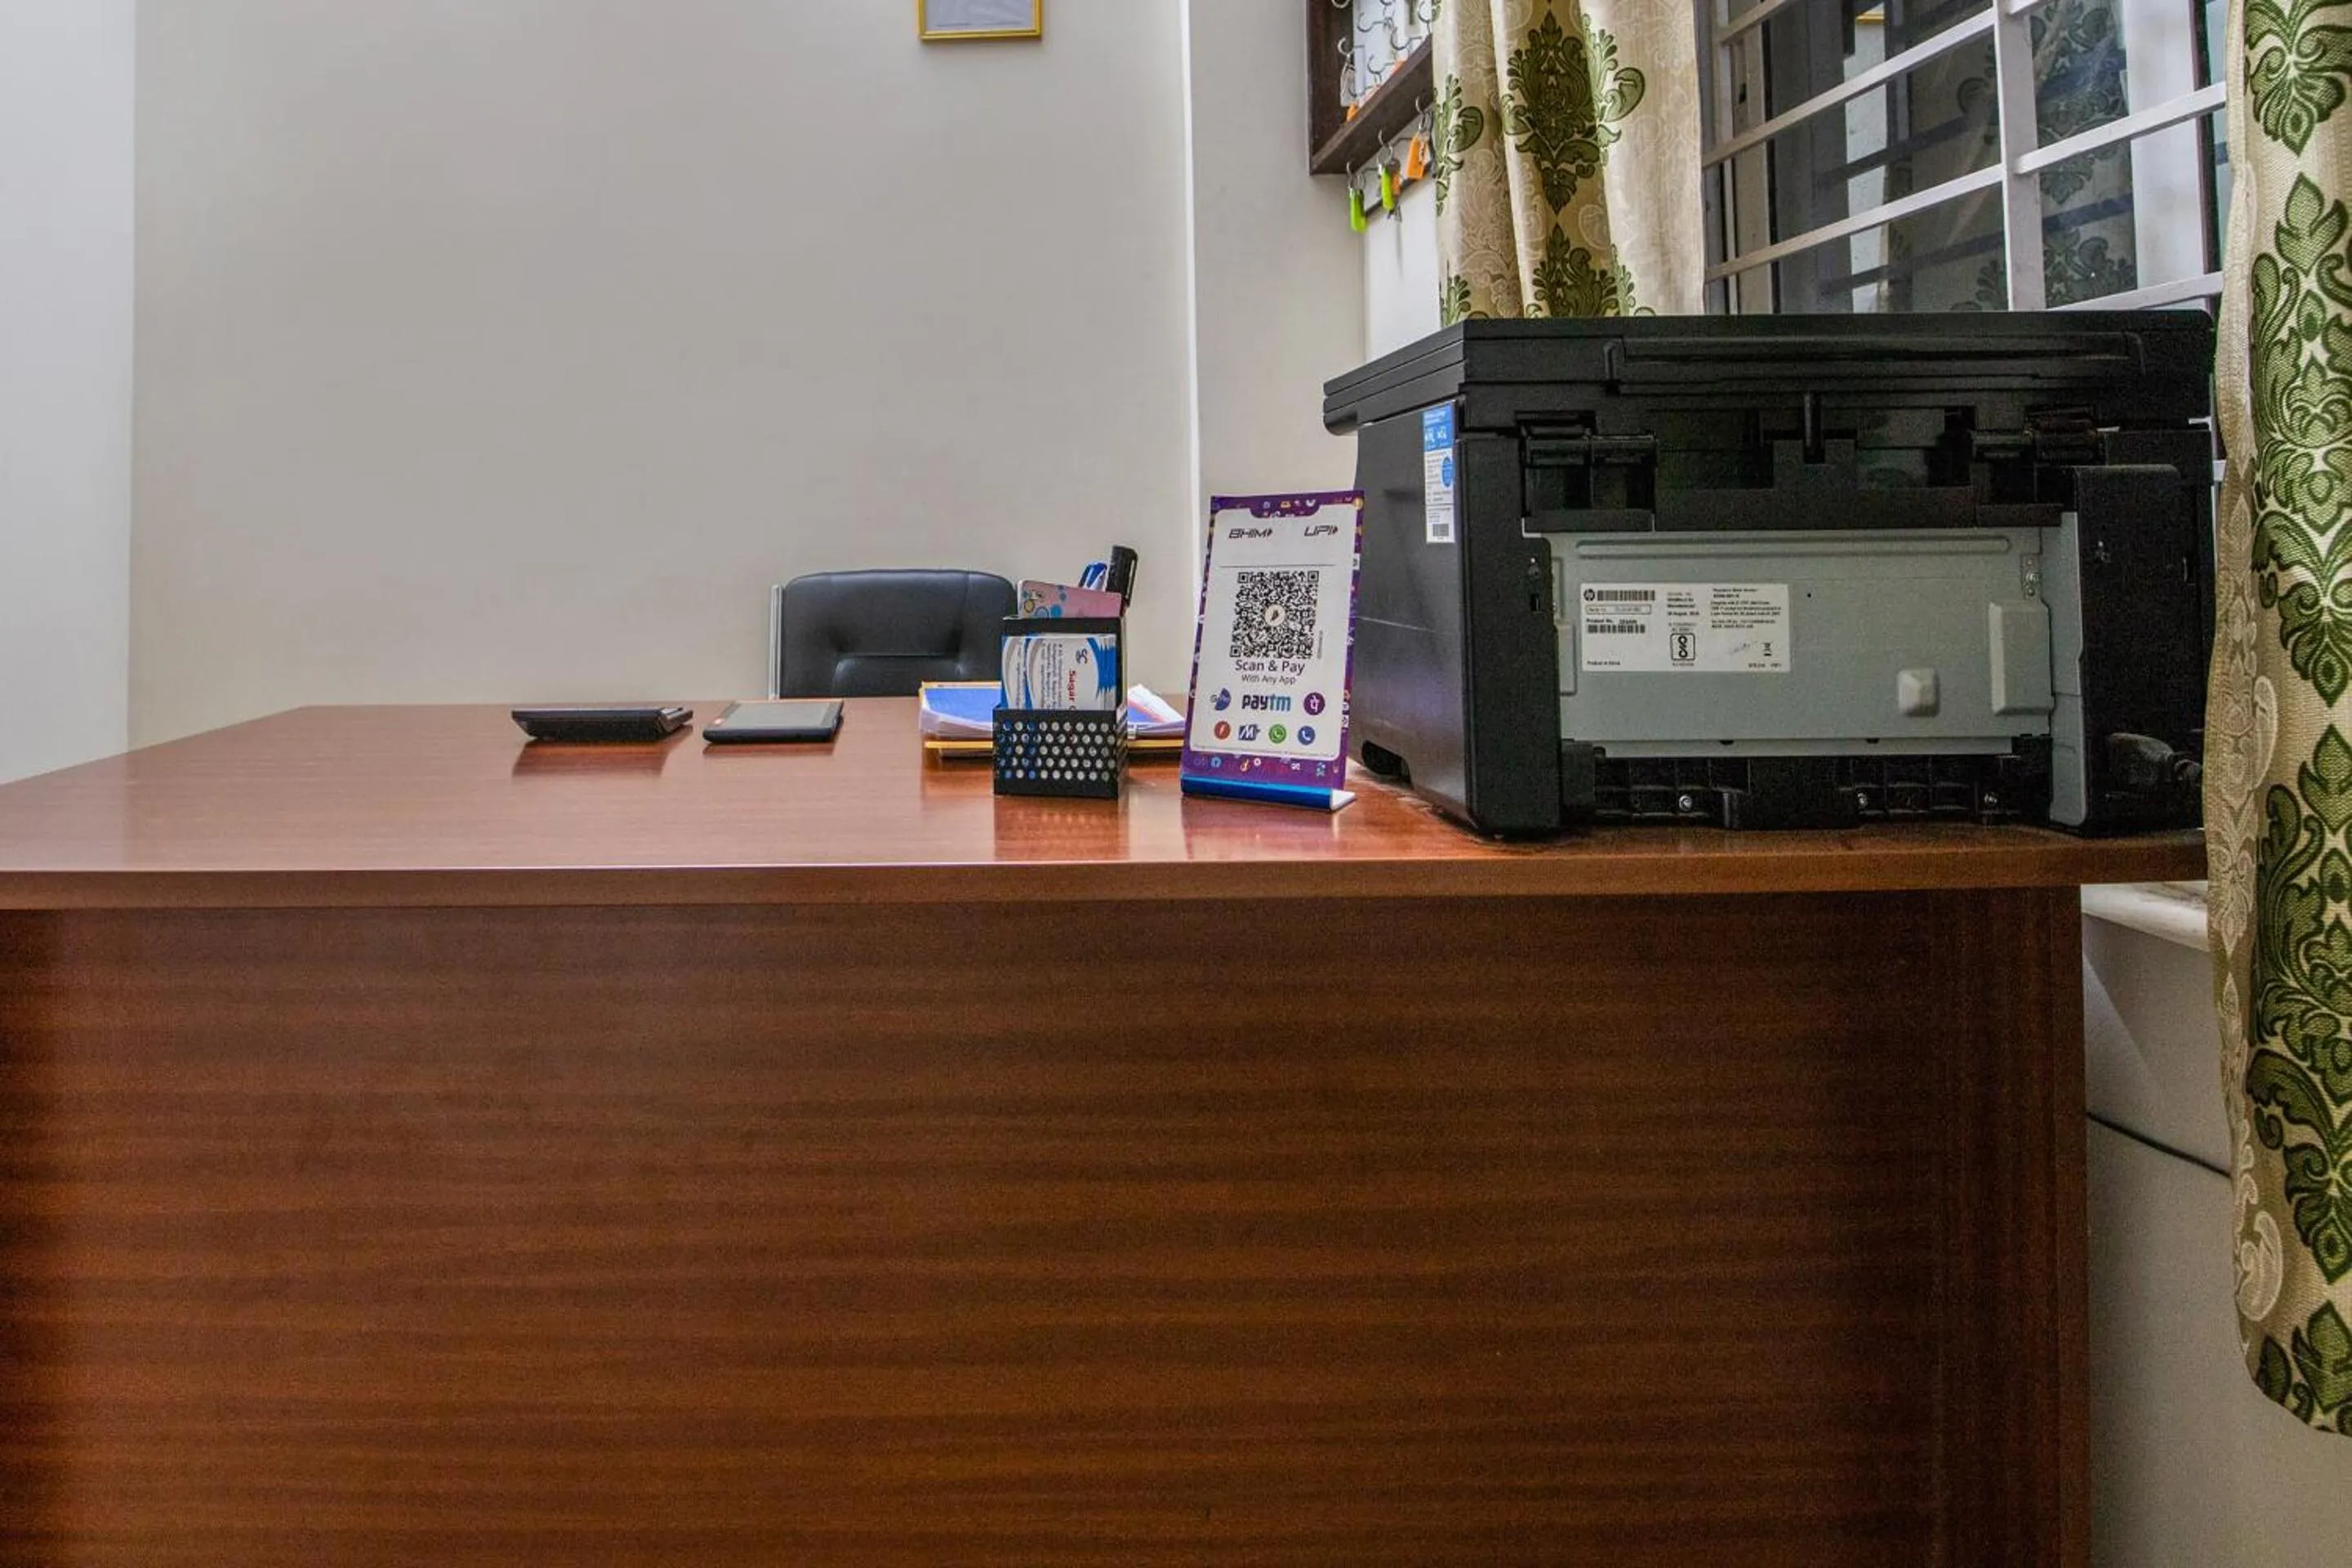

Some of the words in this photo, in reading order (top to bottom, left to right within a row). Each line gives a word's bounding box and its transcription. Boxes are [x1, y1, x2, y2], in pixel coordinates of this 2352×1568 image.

[1228, 528, 1267, 539] BHIM
[1235, 660, 1264, 672] Scan
[1268, 660, 1277, 671] &
[1282, 662, 1305, 676] Pay
[1067, 669, 1076, 702] Sagar
[1241, 675, 1260, 683] With
[1262, 675, 1276, 684] Any
[1279, 675, 1296, 684] App
